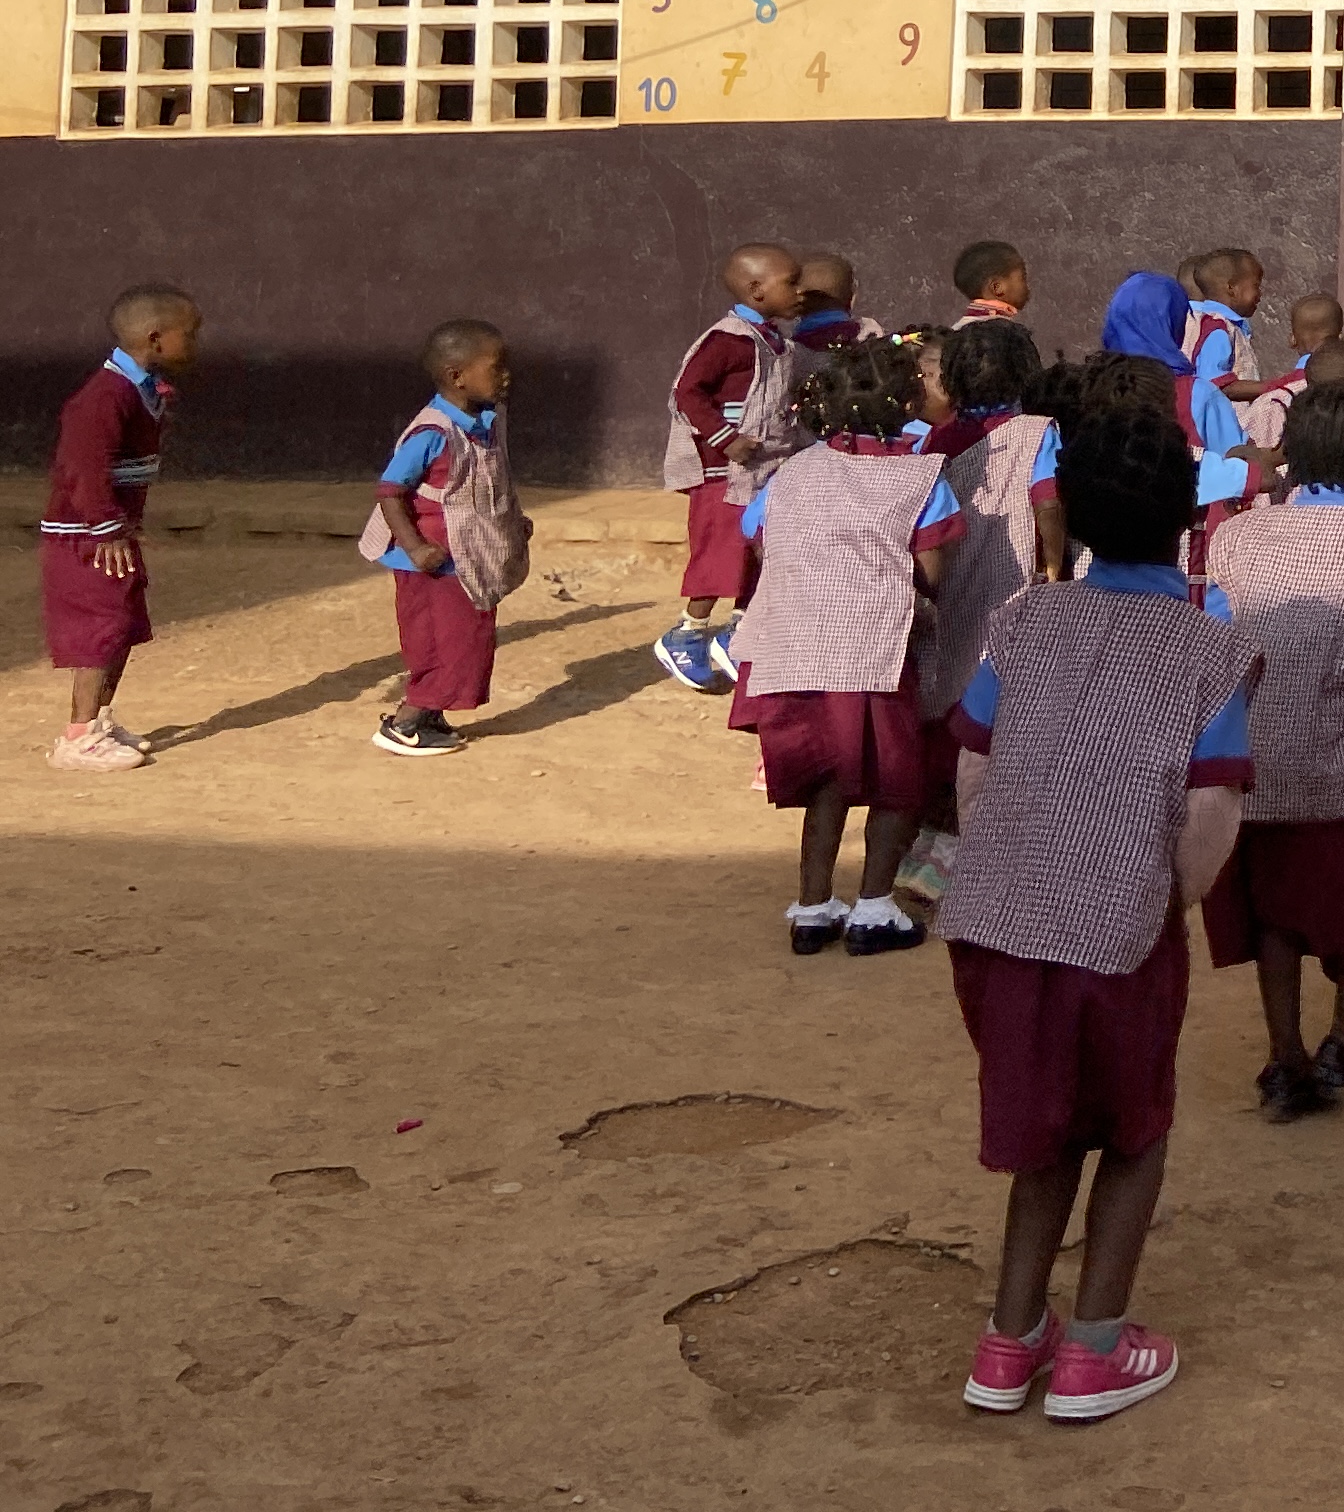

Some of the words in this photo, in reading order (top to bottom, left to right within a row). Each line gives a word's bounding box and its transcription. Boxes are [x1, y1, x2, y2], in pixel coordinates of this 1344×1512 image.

[899, 22, 920, 66] 9
[721, 52, 747, 96] 7
[805, 51, 831, 94] 4
[638, 77, 677, 112] 10
